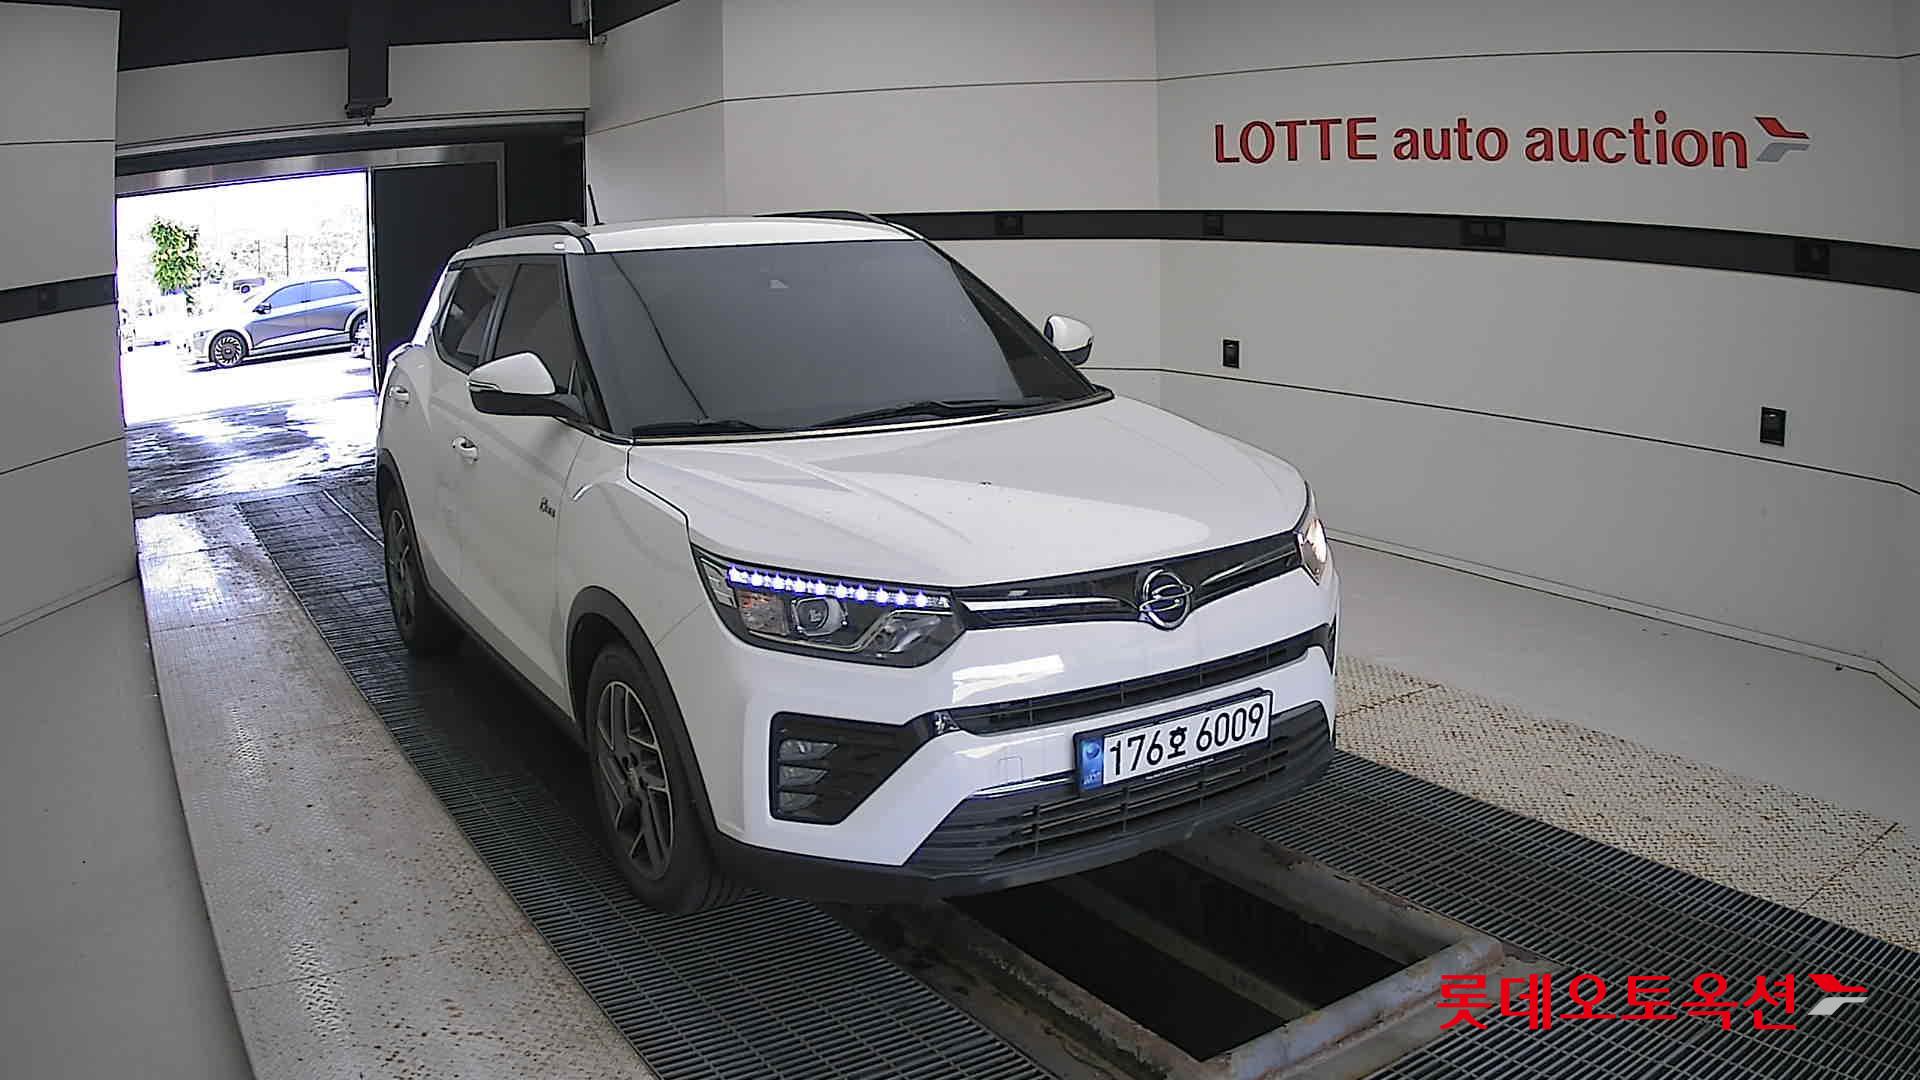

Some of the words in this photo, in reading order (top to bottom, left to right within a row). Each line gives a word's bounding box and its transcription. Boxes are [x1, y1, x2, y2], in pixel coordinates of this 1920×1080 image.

[1215, 117, 1377, 164] LOTTE
[1393, 117, 1508, 162] auto
[1524, 110, 1748, 169] auction
[1110, 726, 1187, 776] 176호
[1196, 702, 1264, 751] 6009
